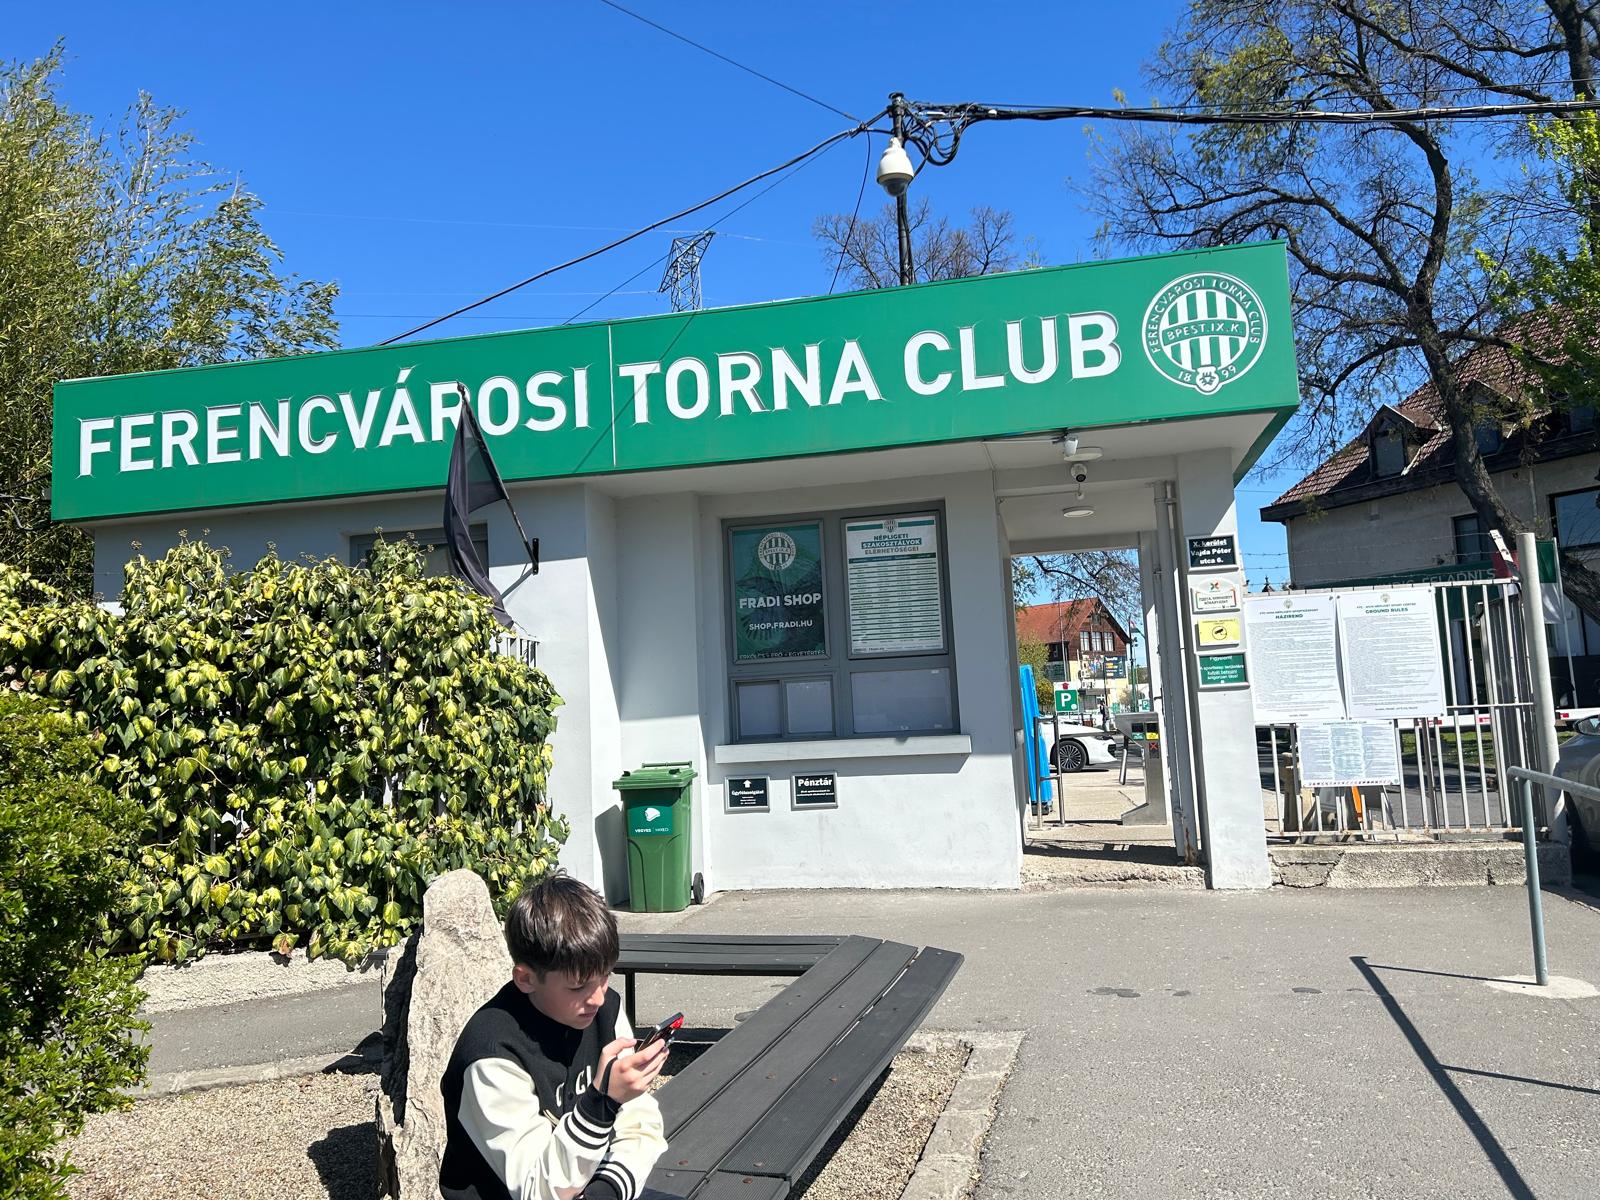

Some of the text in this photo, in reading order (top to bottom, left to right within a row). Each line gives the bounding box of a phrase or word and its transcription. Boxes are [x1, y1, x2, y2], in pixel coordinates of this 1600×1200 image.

[79, 311, 1121, 477] FERENCVÁROSI TORNA CLUB
[739, 593, 822, 609] FRADI SHOP
[748, 619, 814, 631] SHOP.FRADI.HU
[1061, 692, 1072, 707] P
[797, 777, 833, 787] Pénztár
